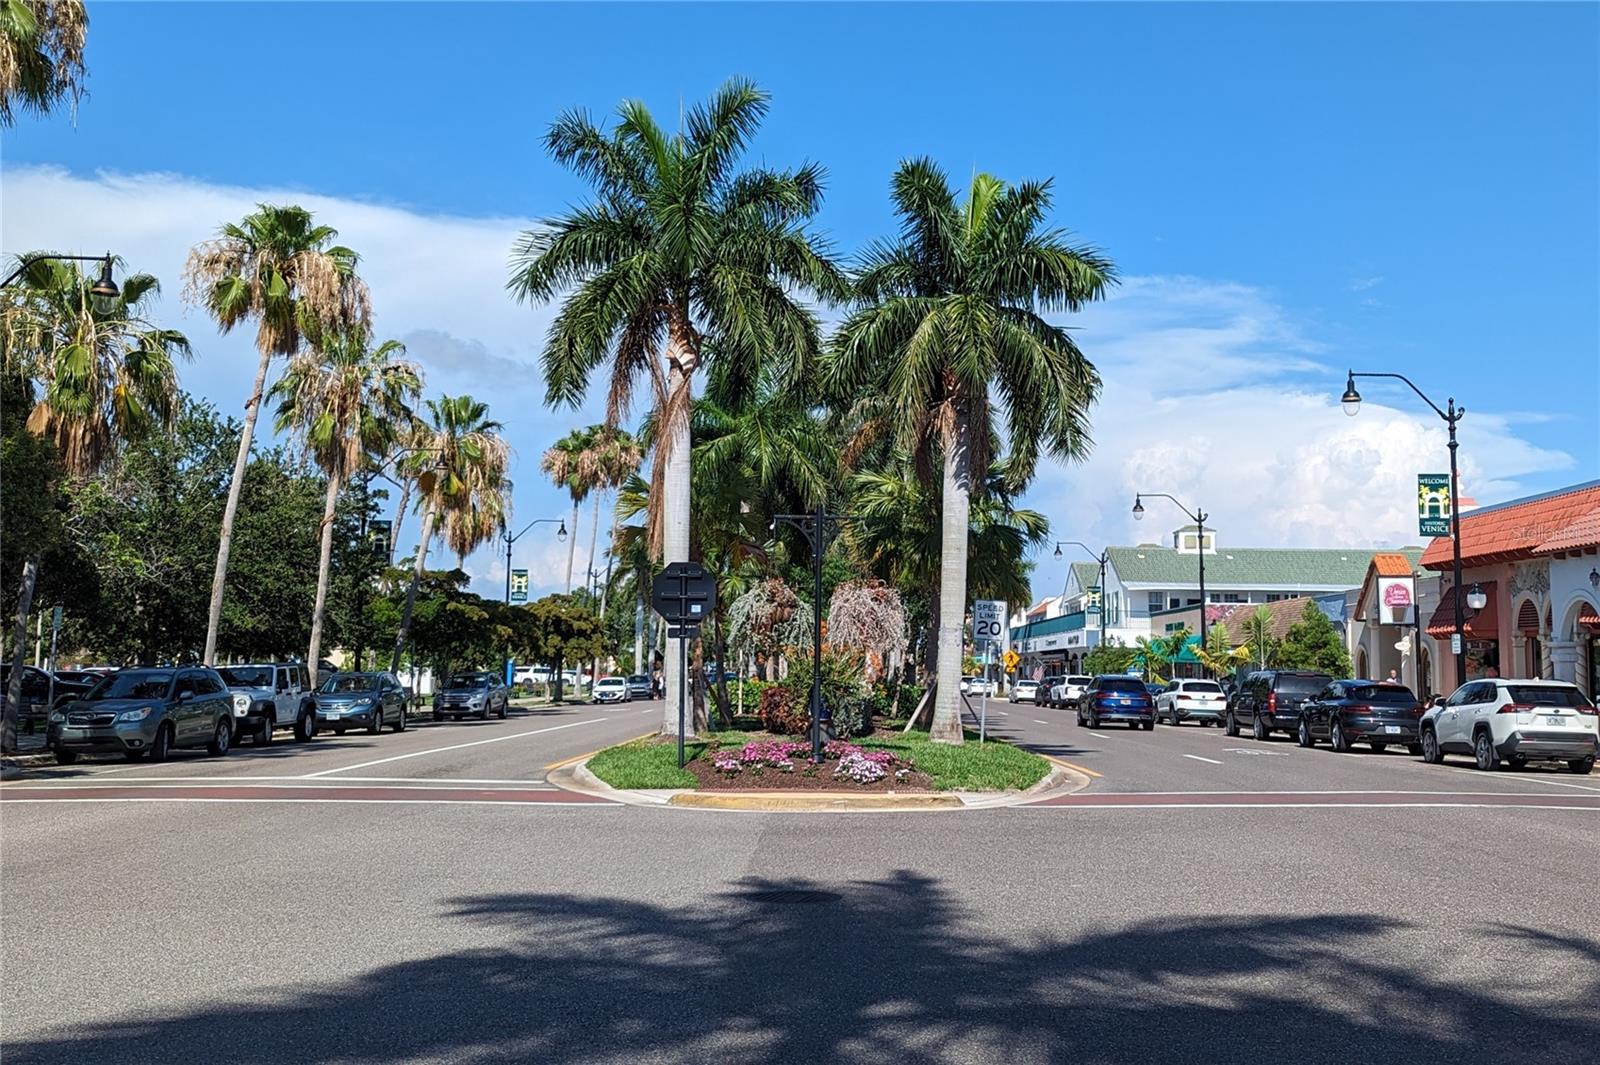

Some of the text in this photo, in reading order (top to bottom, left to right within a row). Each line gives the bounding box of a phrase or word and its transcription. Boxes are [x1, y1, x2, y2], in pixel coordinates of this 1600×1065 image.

[1421, 525, 1449, 533] VENICE
[977, 603, 1004, 612] SPEED
[979, 612, 1001, 620] LIMIT
[976, 620, 1001, 636] 20
